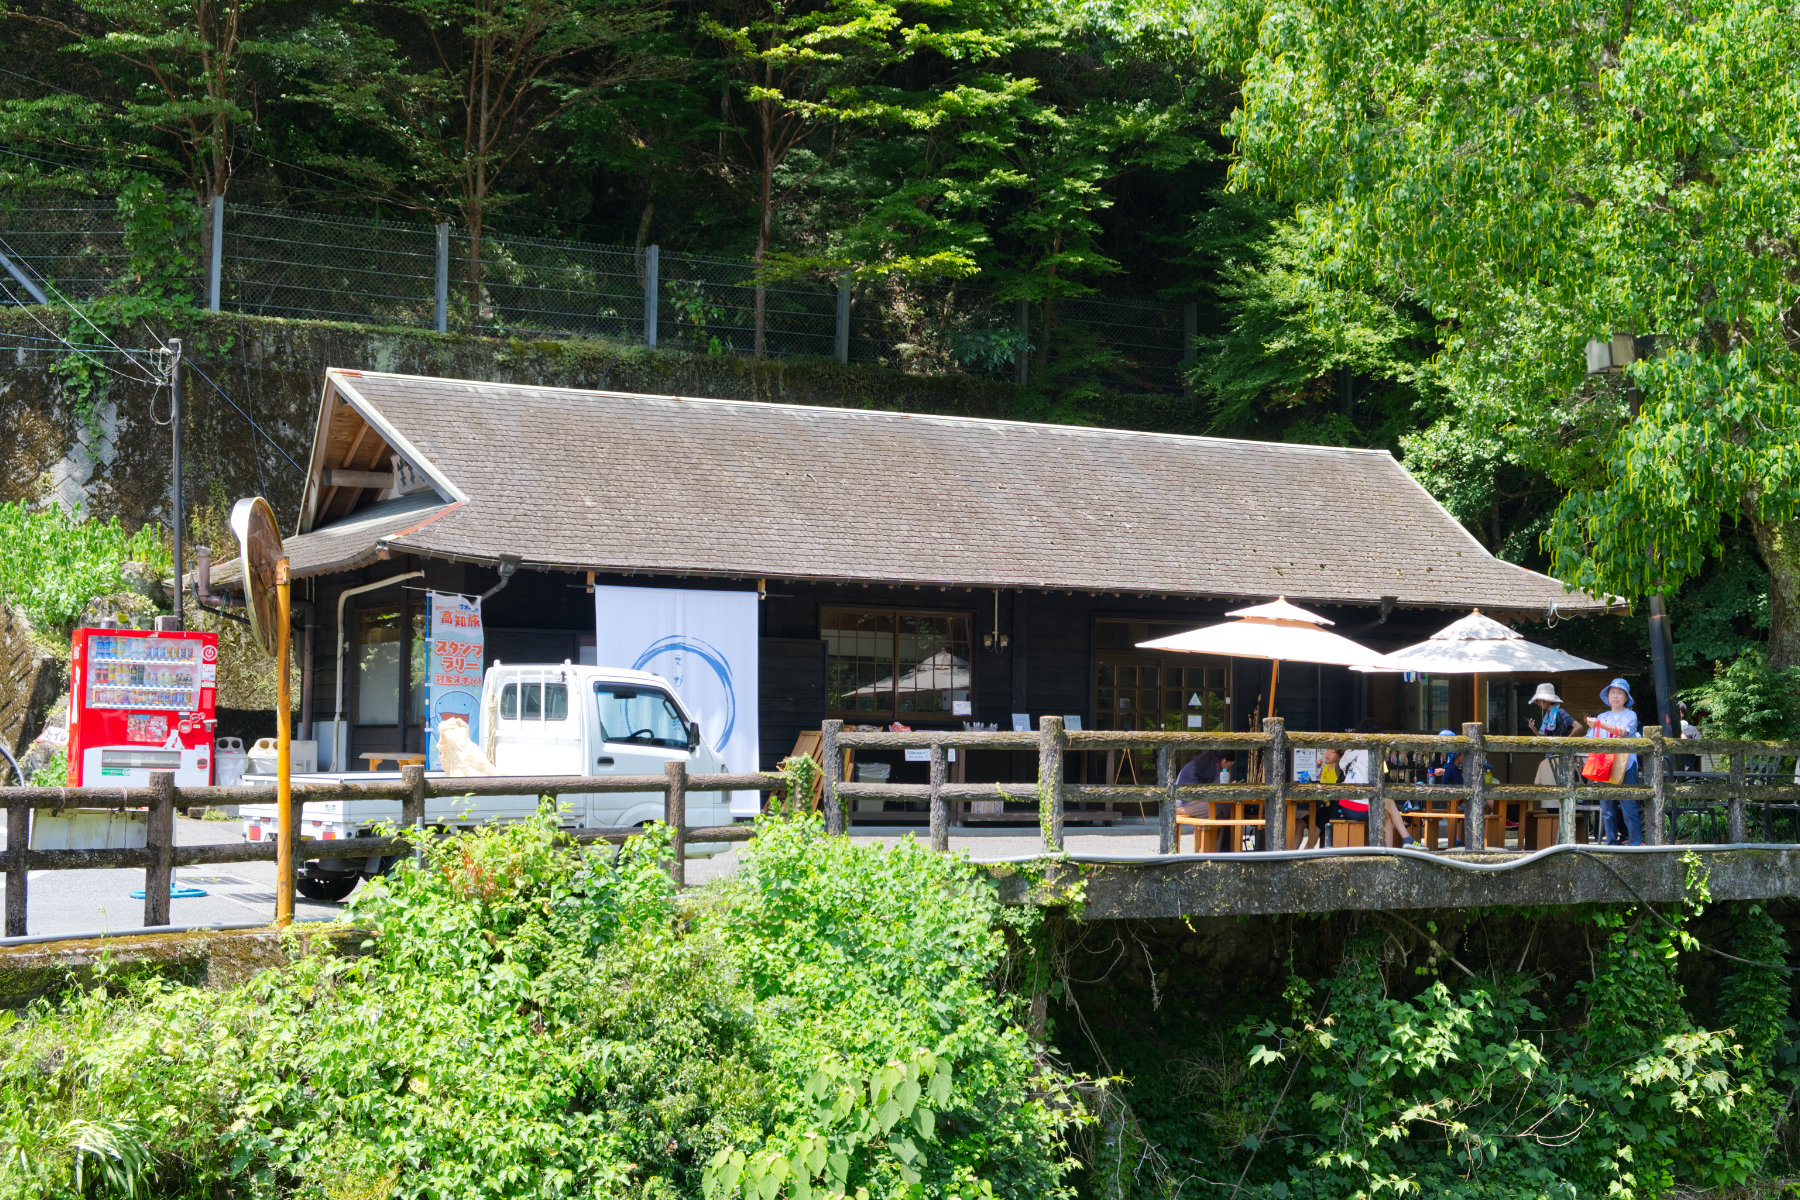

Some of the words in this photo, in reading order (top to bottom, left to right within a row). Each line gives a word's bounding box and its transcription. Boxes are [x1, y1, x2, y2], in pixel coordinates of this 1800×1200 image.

[441, 611, 480, 627] 高知旅
[441, 656, 480, 674] ラリー
[46, 728, 67, 742] トイレ
